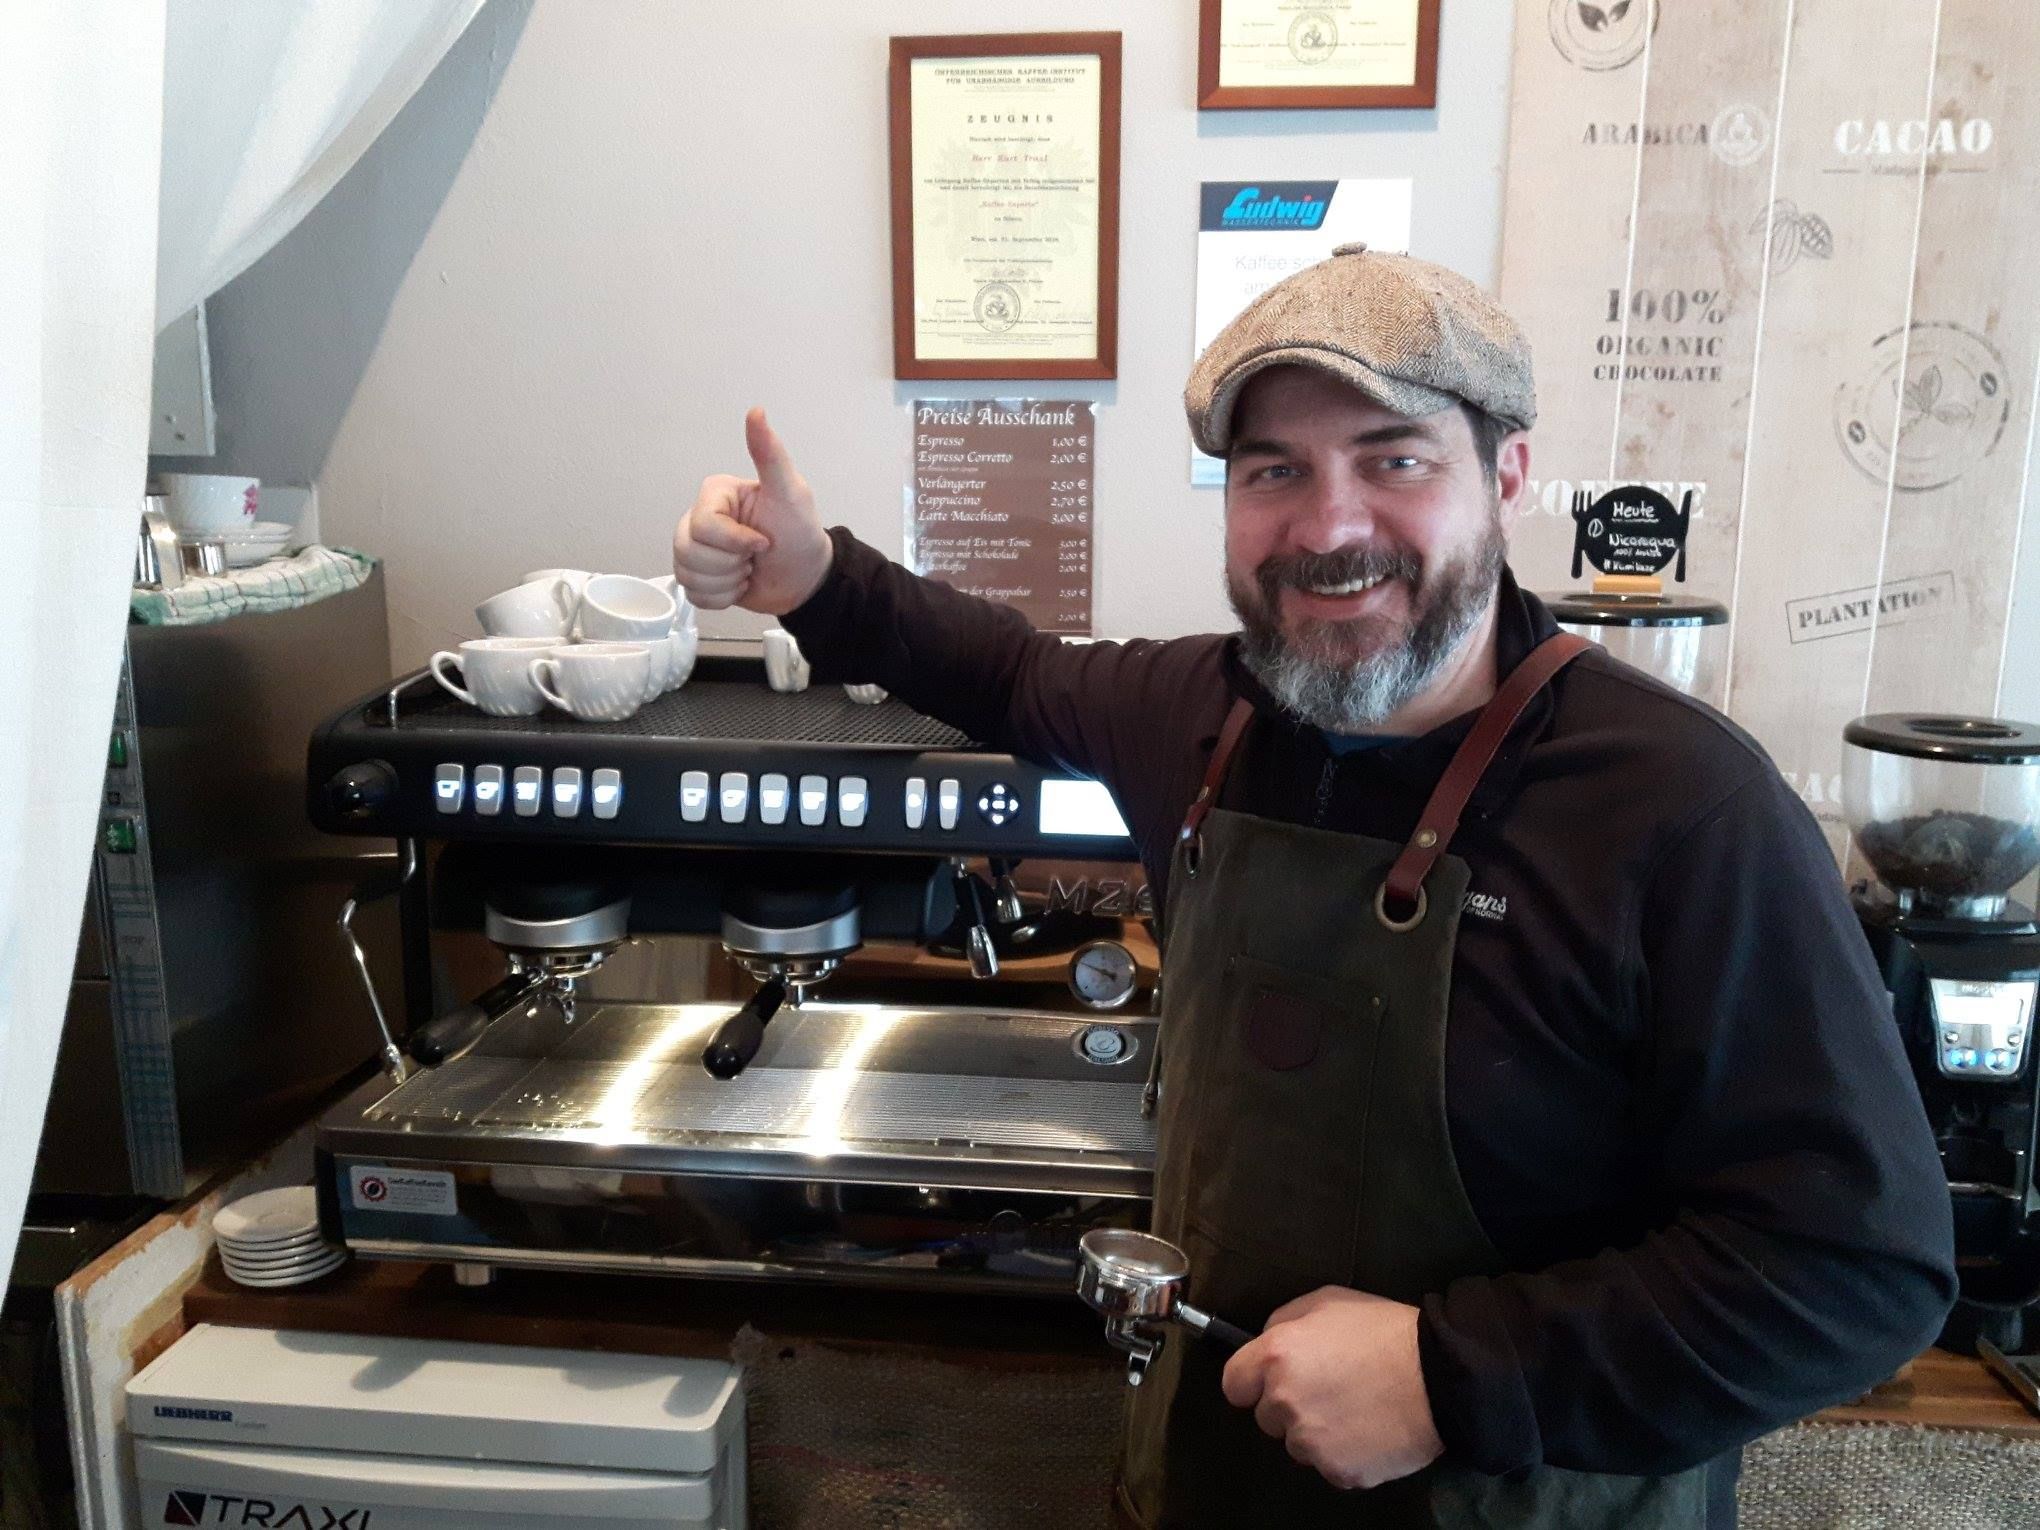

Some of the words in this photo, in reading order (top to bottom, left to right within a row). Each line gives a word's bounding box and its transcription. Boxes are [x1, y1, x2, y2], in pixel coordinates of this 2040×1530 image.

[1836, 119, 1993, 153] CACAO
[1222, 187, 1324, 226] Ludwig
[1605, 288, 1724, 324] 100%
[1596, 335, 1723, 357] ORGANIC
[1593, 364, 1722, 382] CHOCOLATE
[917, 407, 972, 426] Preise
[977, 403, 1076, 426] Ausschank
[917, 434, 965, 451] Espresso
[1078, 436, 1087, 447] €
[917, 451, 964, 467] Espresso
[967, 451, 1013, 463] Corretto
[1078, 452, 1087, 463] €
[1050, 481, 1074, 491] 2,50
[1078, 479, 1087, 490] €
[917, 494, 981, 510] Cappuccino
[1078, 495, 1087, 506] €
[1613, 501, 1654, 518] Heute
[918, 510, 948, 522] Latte
[950, 508, 1009, 522] Macchiato
[1078, 512, 1087, 522] €
[919, 537, 954, 550] Espresso
[1798, 587, 1941, 628] PLANTATION
[154, 1406, 232, 1422] LIEBHERR
